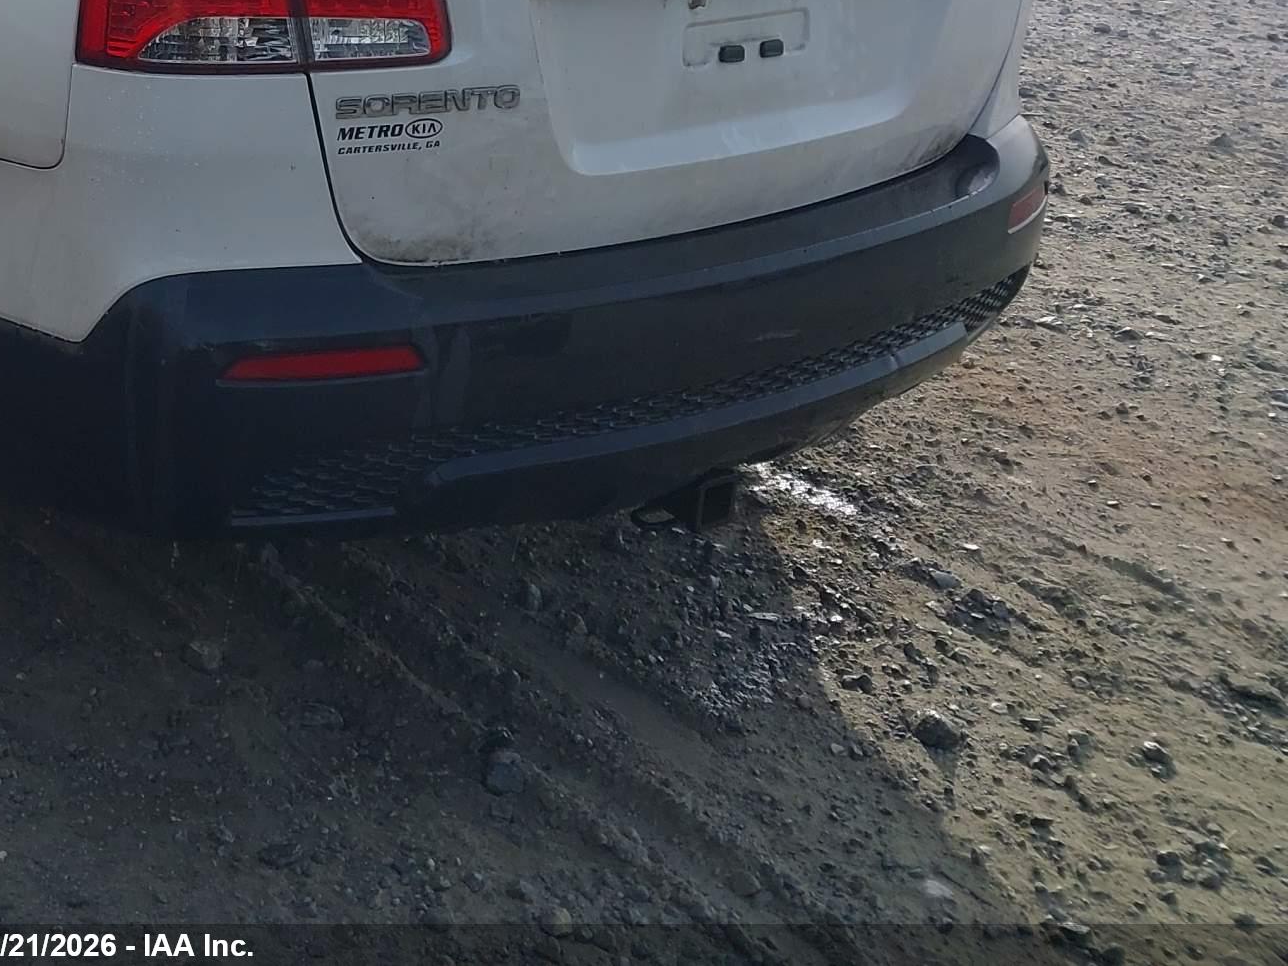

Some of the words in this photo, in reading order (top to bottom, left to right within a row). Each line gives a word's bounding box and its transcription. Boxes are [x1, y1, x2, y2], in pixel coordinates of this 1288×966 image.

[335, 84, 521, 120] SORENTO
[337, 123, 404, 141] METRO
[411, 122, 437, 135] KIA
[337, 141, 423, 155] CARTERSVILLE,
[425, 140, 441, 149] GA
